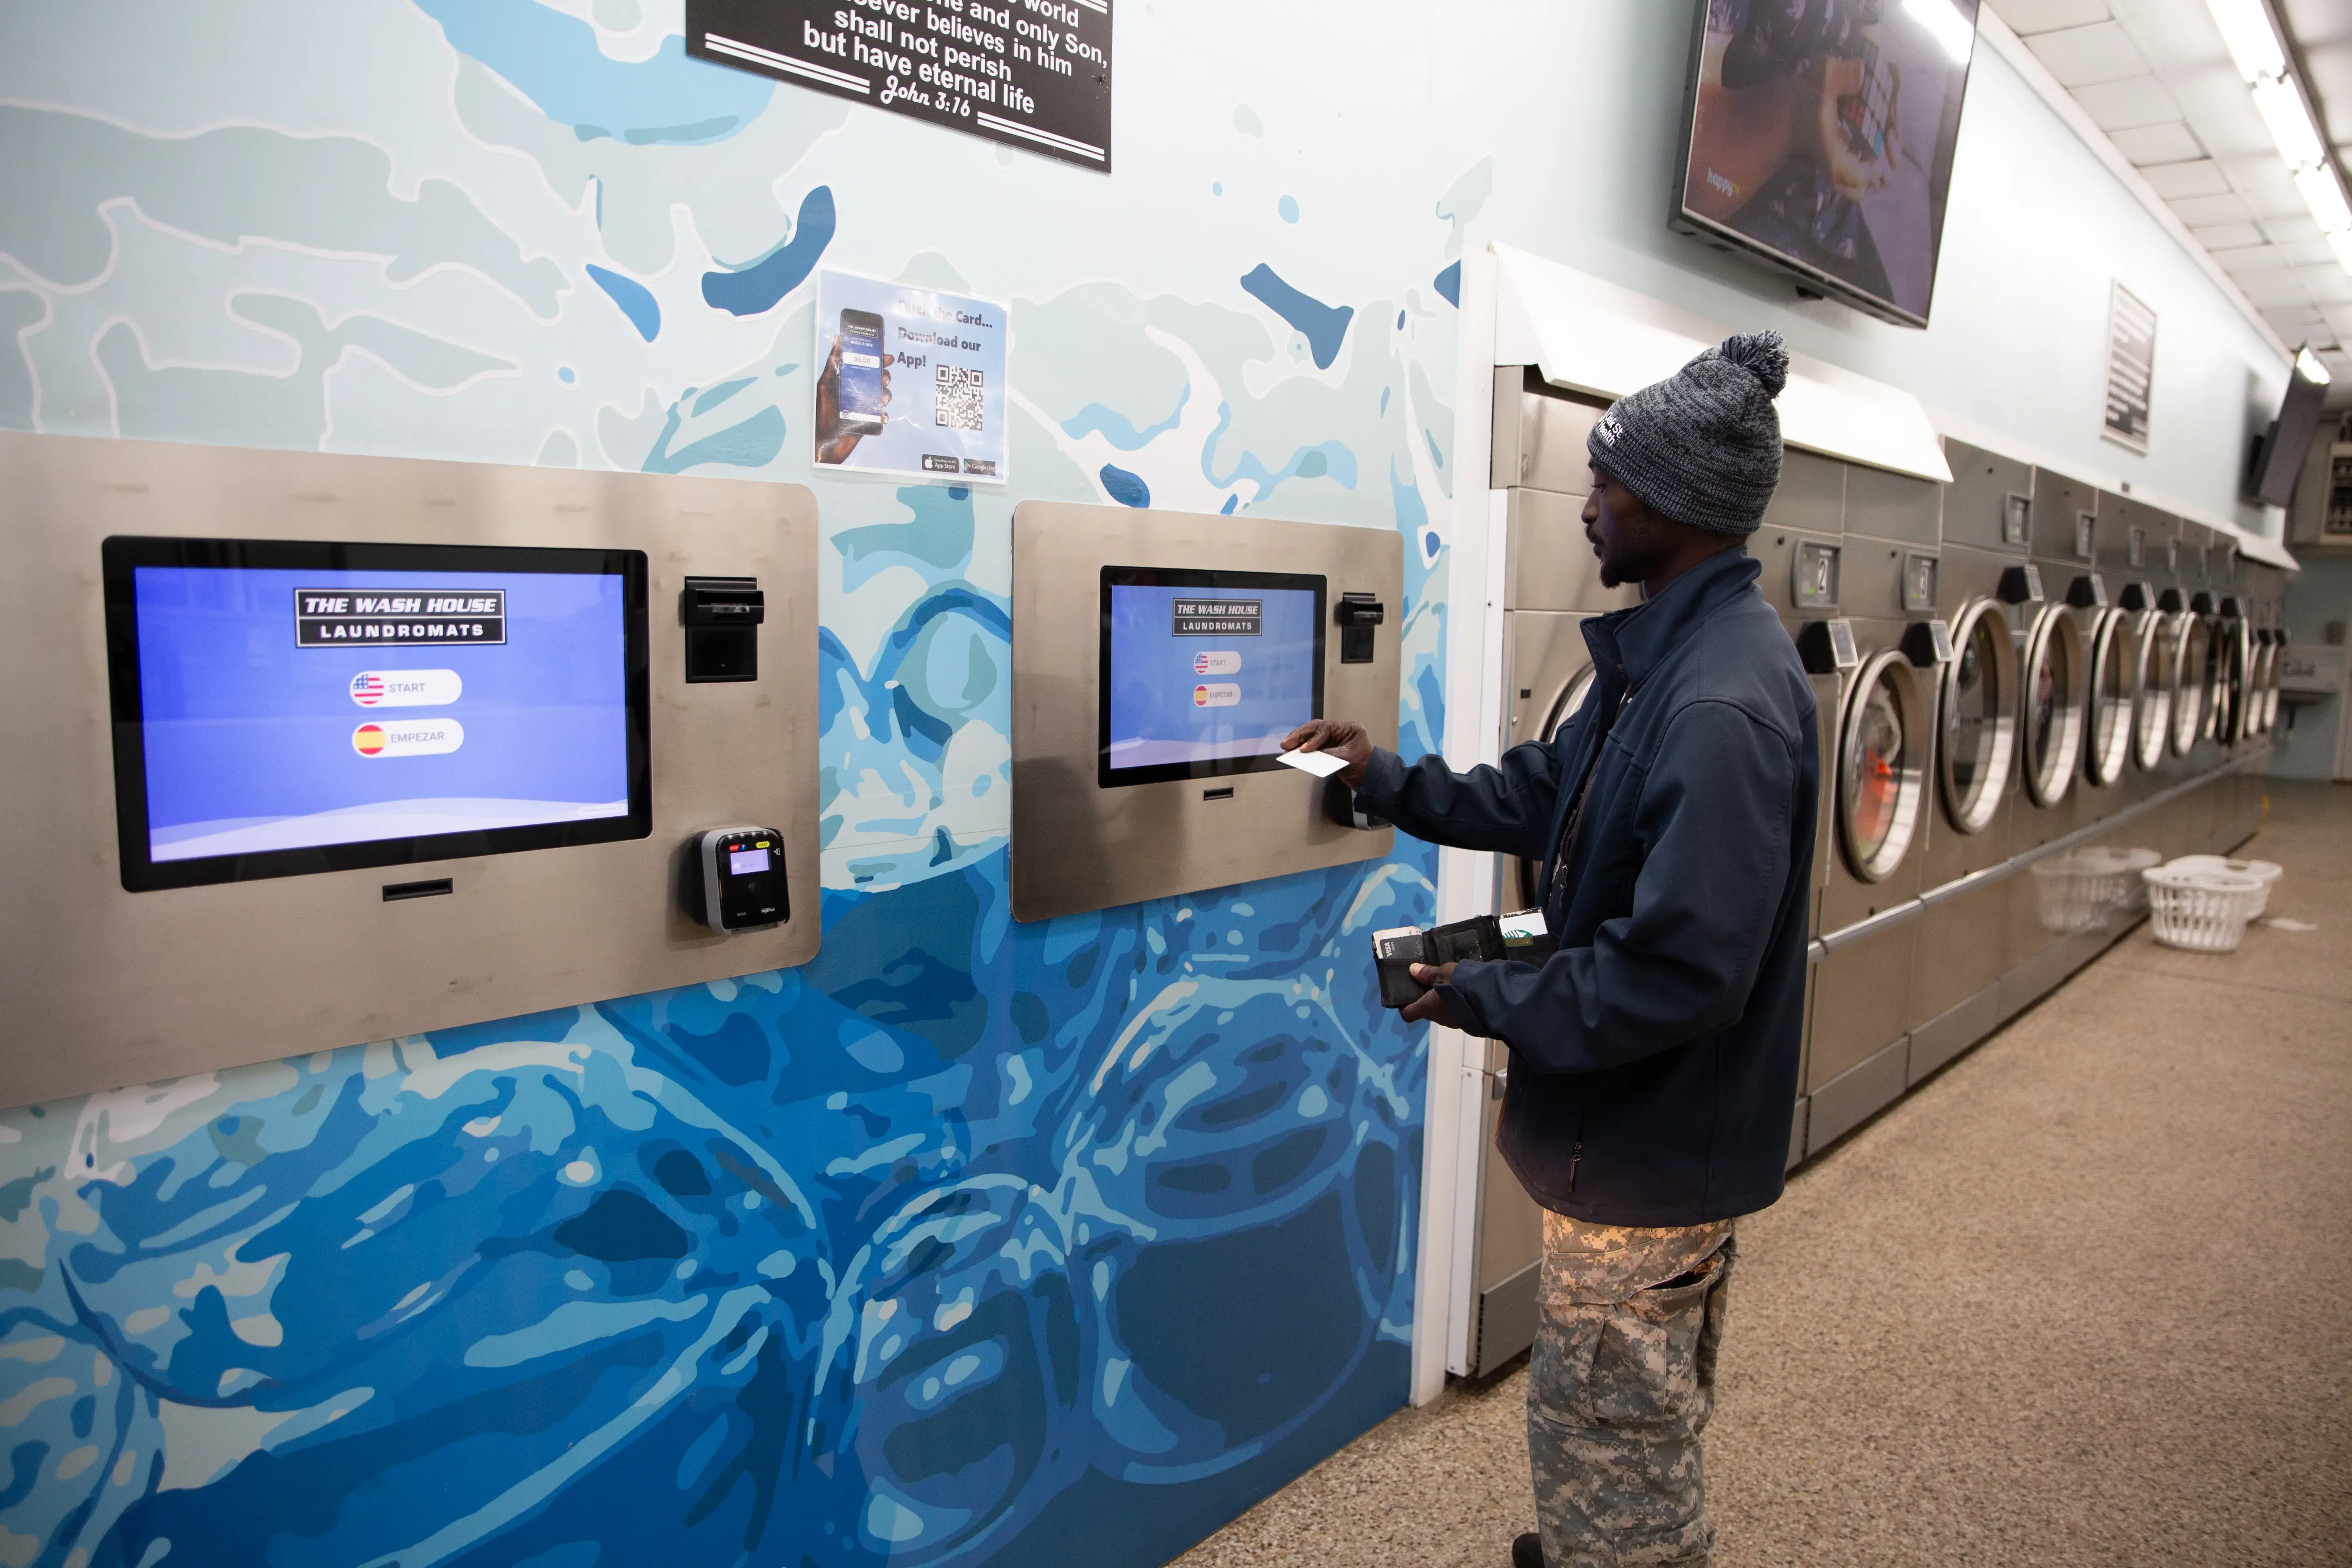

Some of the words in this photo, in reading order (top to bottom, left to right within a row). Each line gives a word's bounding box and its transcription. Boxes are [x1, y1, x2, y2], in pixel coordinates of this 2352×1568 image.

[1024, 0, 1078, 28] world
[927, 7, 1004, 53] believes
[1014, 38, 1031, 62] in
[1038, 46, 1072, 76] him
[970, 2, 1009, 29] and
[1016, 20, 1060, 50] only
[1065, 33, 1107, 69] Son,
[835, 9, 892, 43] shall
[901, 31, 938, 58] not
[945, 46, 1011, 82] perish
[804, 20, 846, 57] but
[854, 36, 912, 76] have
[919, 62, 996, 102] eternal
[1003, 83, 1034, 114] life
[880, 75, 930, 106] John
[935, 91, 970, 117] 3:16
[956, 311, 993, 328] Card...
[898, 327, 958, 348] Download
[961, 340, 981, 352] our
[897, 352, 927, 369] App!
[1598, 419, 1615, 445] Health
[1605, 411, 1617, 429] Oak
[1612, 423, 1623, 439] St.
[972, 463, 987, 472] Google
[305, 597, 349, 613] THE
[355, 597, 421, 613] WASH
[426, 598, 497, 612] HOUSE
[1177, 605, 1196, 614] THE
[1198, 605, 1226, 615] WASH
[1228, 605, 1258, 615] HOUSE
[320, 624, 483, 638] LAUNDROMATS
[1183, 622, 1252, 630] LAUNDROMATS
[389, 682, 426, 693] START
[391, 731, 445, 744] EMPEZAR
[1384, 942, 1392, 958] VISA
